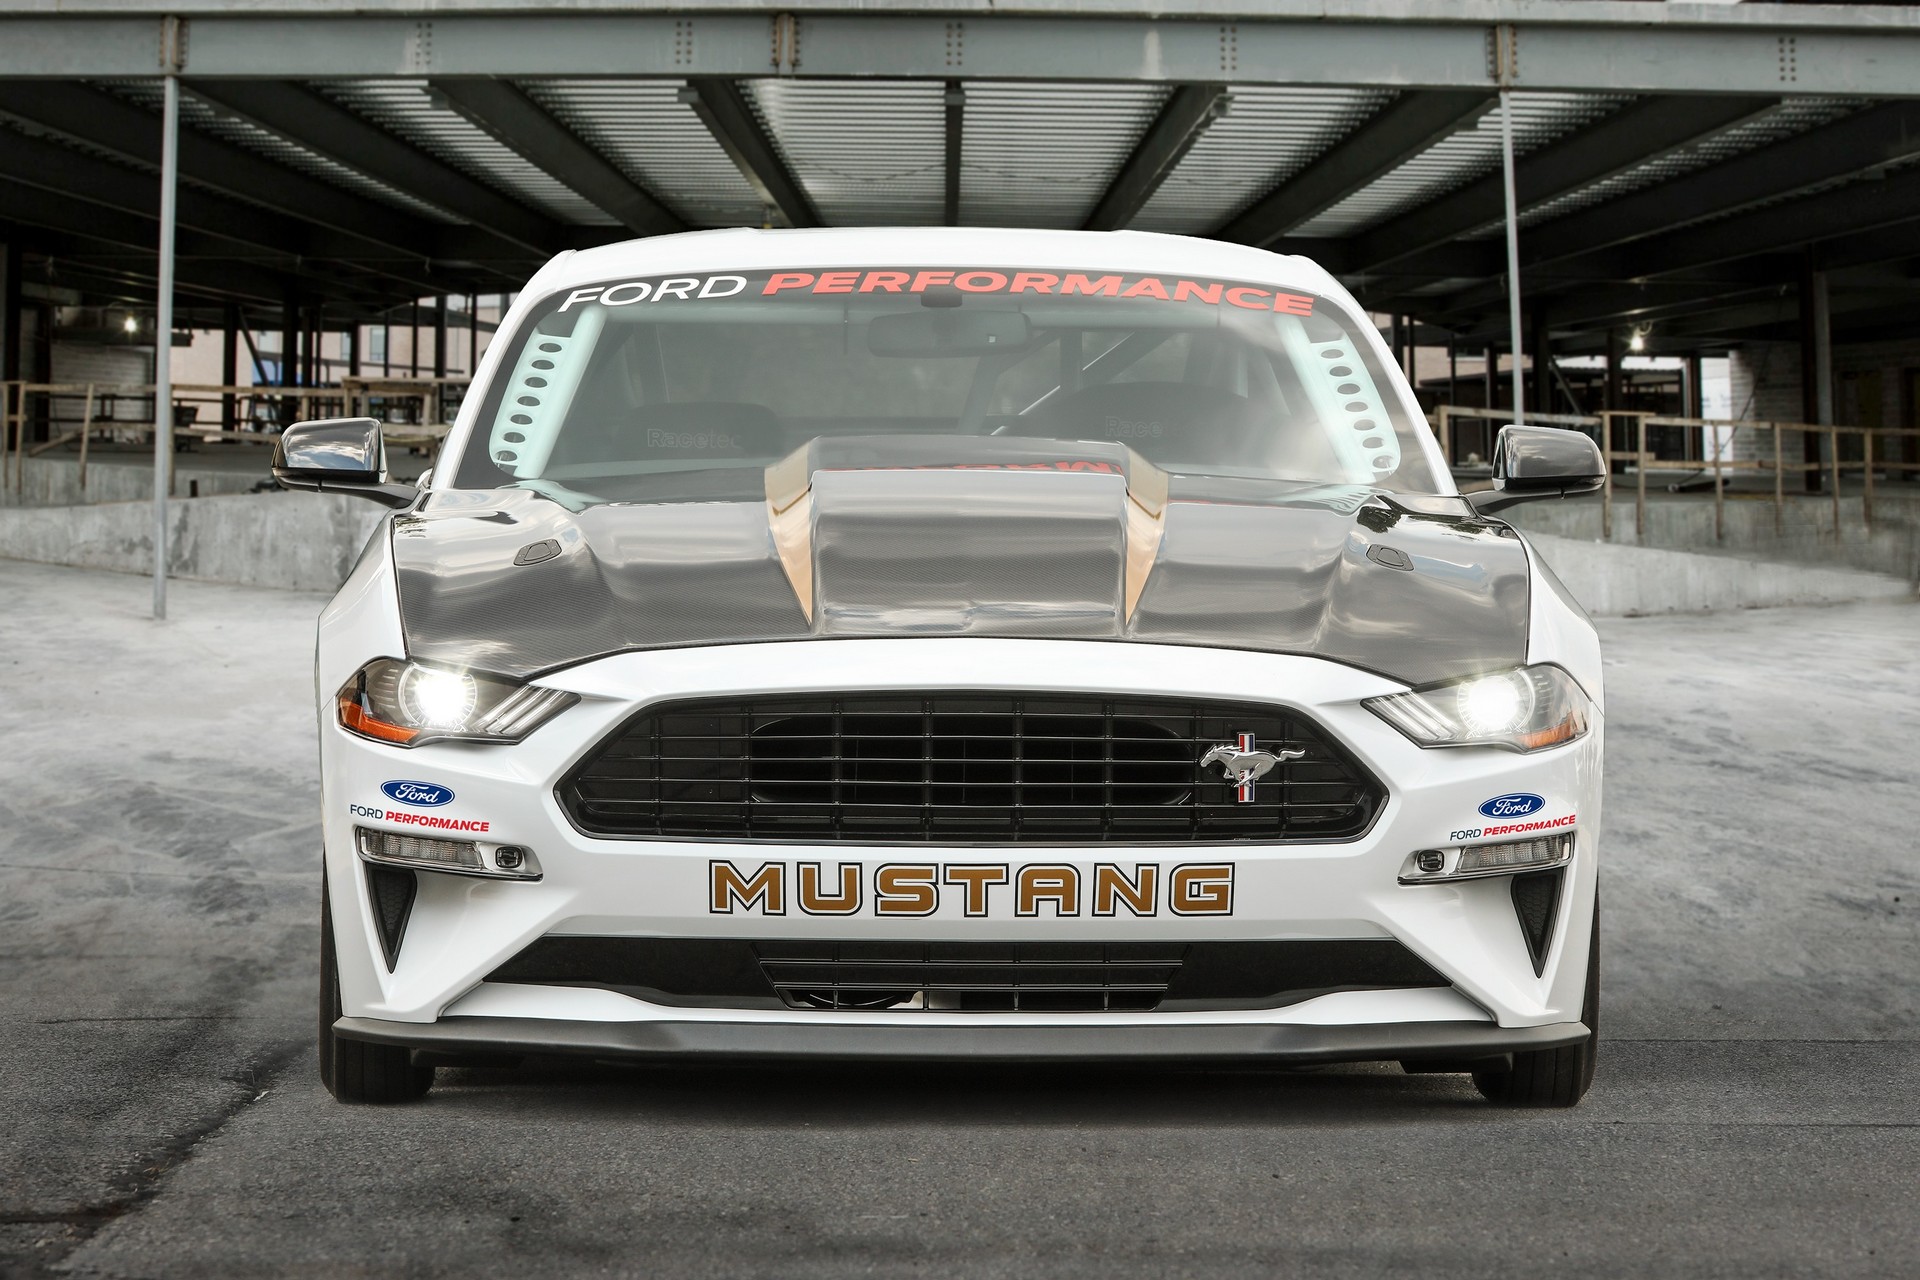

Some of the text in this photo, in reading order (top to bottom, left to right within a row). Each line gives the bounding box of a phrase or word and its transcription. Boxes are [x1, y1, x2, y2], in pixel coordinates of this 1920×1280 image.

[557, 270, 1315, 317] FORD PERFORMANCE
[395, 783, 438, 803] Ford
[1492, 798, 1532, 815] Ford
[350, 804, 490, 832] FORD PERFORMANCE
[1450, 815, 1576, 841] FORD PERFORMANCE
[708, 859, 1236, 918] MUSTANG
